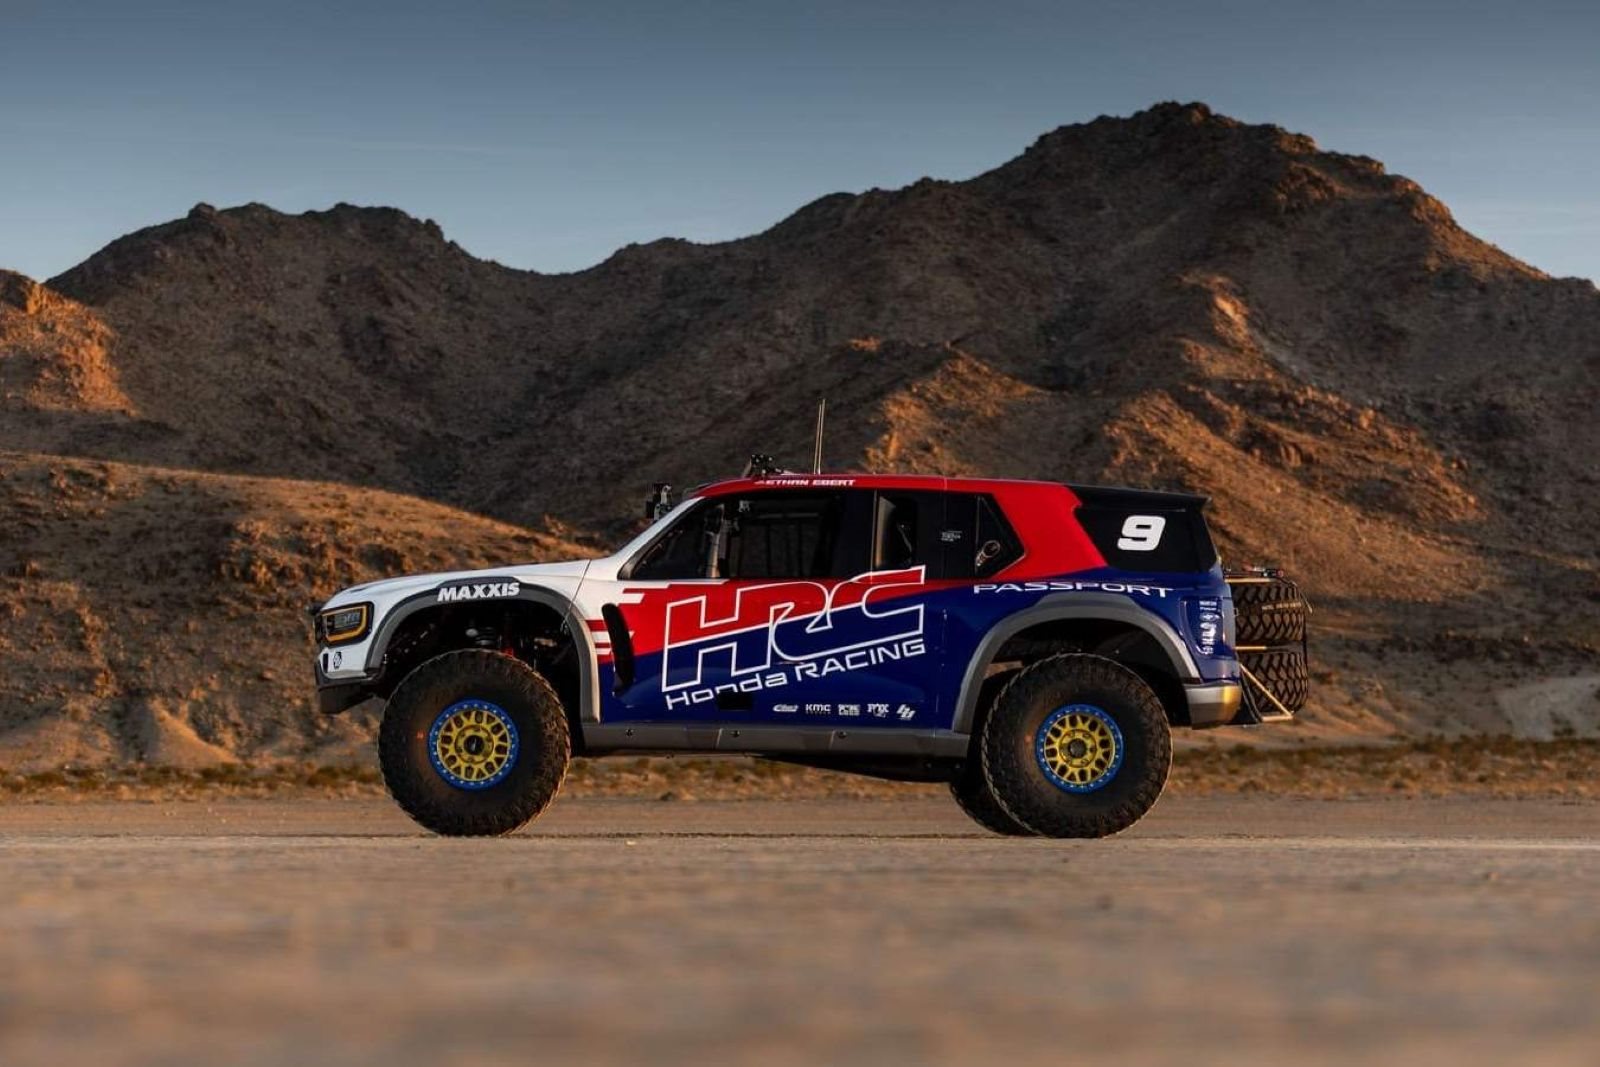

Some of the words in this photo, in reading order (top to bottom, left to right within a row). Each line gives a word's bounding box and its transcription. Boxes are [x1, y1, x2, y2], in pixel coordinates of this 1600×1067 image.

[1117, 515, 1166, 551] 9
[437, 582, 520, 602] MAXXIS
[974, 582, 1172, 598] PASSPORT
[661, 565, 926, 692] HRC
[666, 671, 788, 710] Honda
[794, 638, 926, 682] RACING
